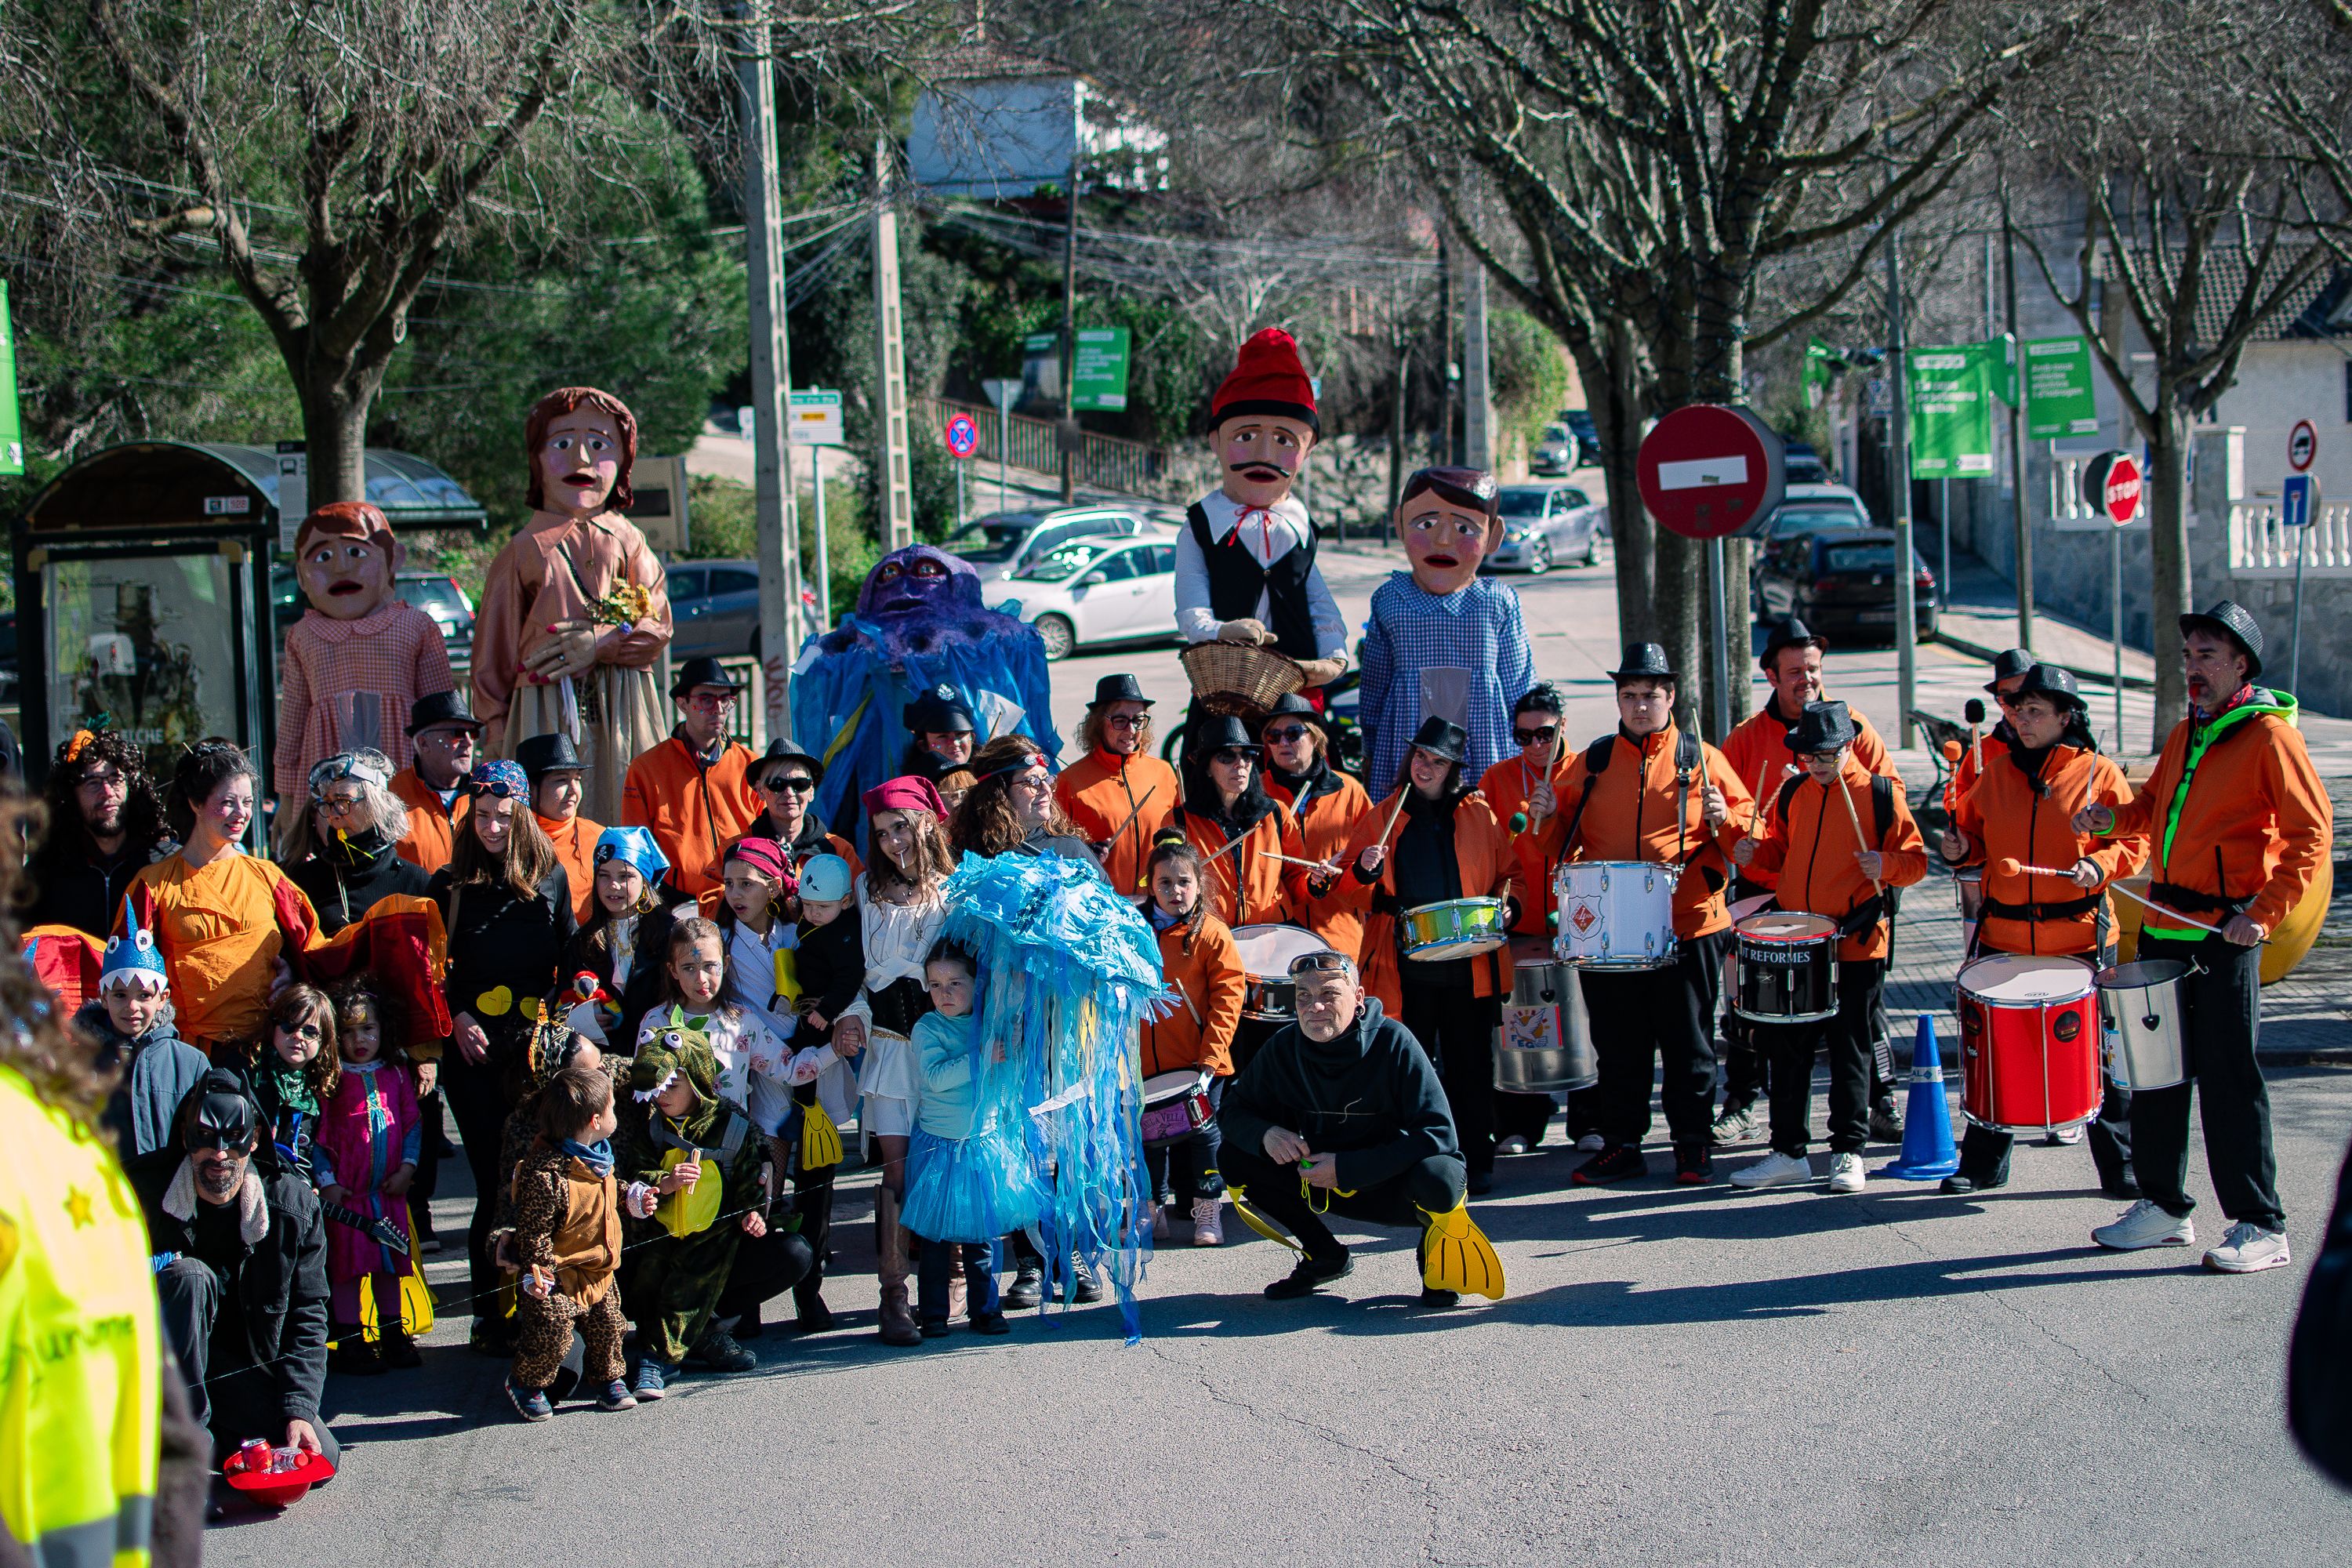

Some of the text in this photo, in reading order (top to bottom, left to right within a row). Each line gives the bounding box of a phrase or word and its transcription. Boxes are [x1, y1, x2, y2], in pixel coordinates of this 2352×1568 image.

[2107, 479, 2140, 504] STOP
[1751, 949, 1810, 964] REFORMES
[1873, 1040, 1894, 1083] PUMA
